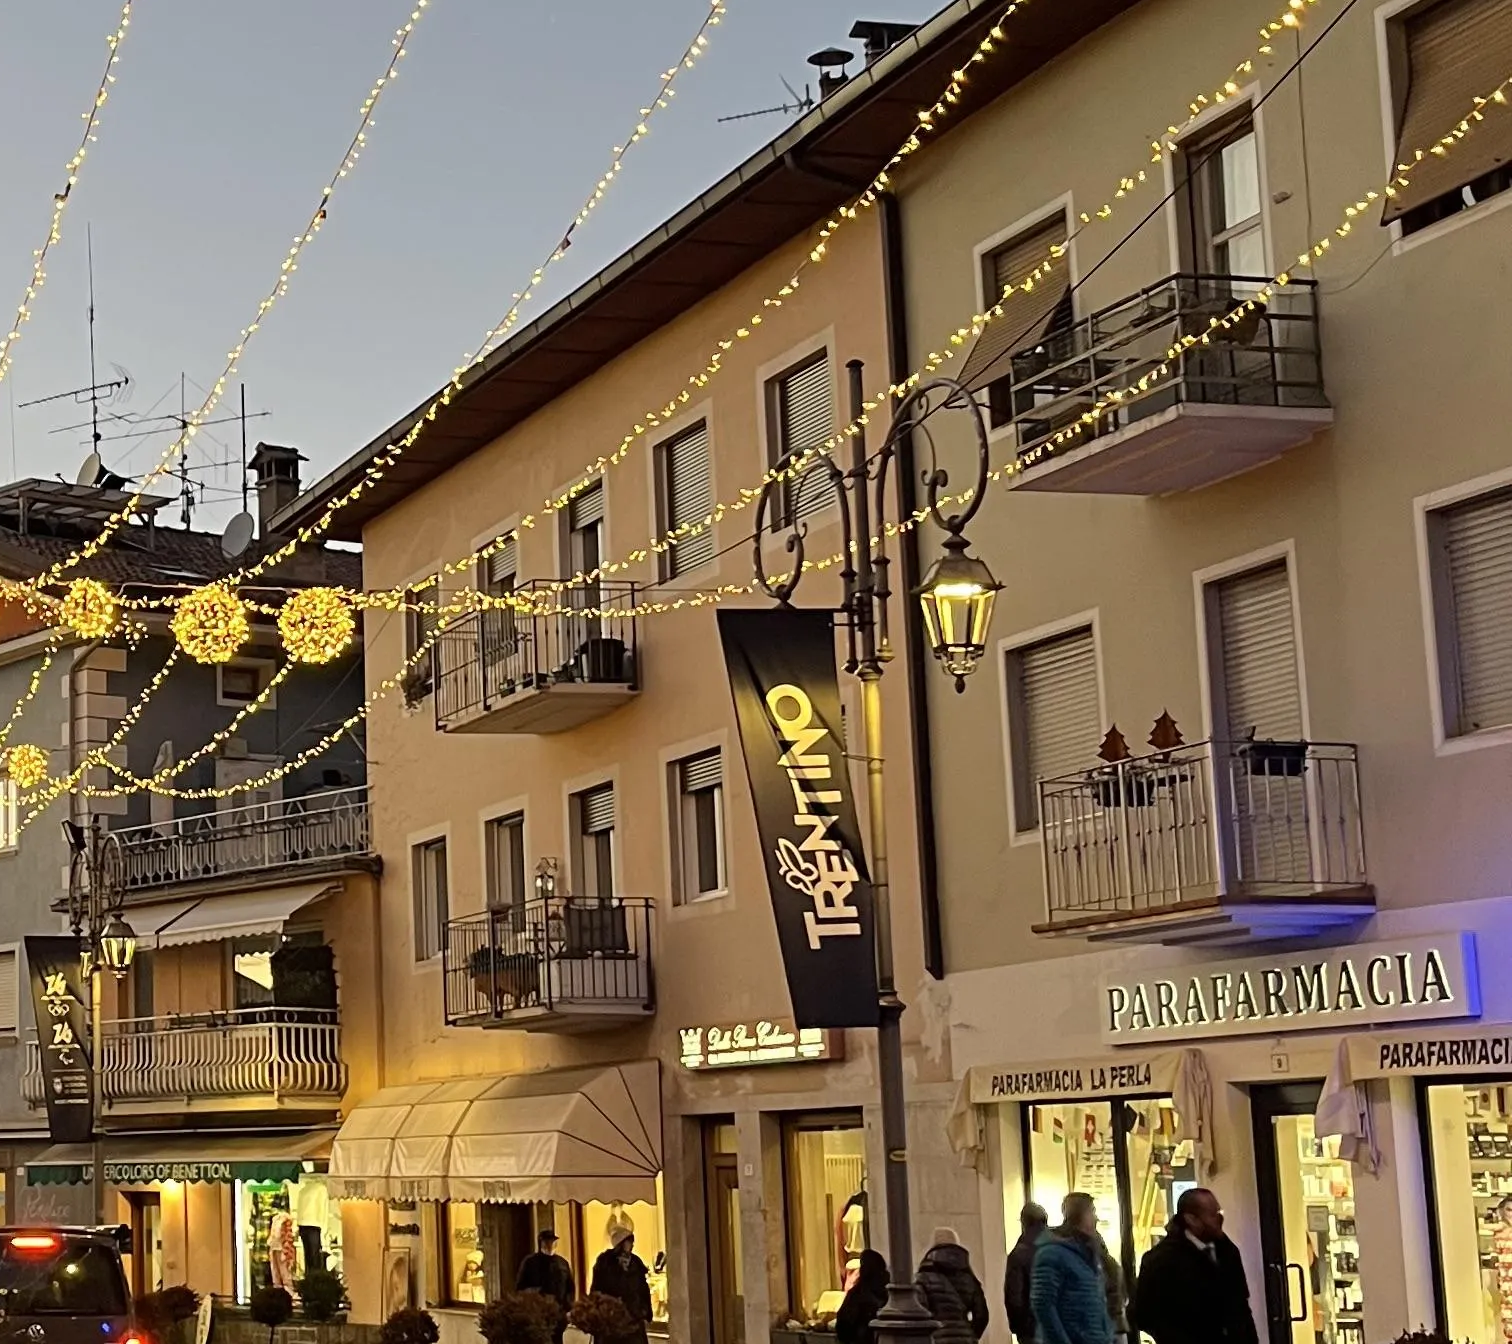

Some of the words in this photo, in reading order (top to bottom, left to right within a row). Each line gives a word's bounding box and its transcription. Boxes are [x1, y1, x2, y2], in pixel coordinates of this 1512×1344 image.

[765, 683, 862, 951] TRENTINO
[1108, 948, 1456, 1032] PARAFARMACIA
[1379, 1037, 1512, 1070] PARAFARMACI
[991, 1069, 1083, 1097] PARAFARMACIA
[1090, 1067, 1107, 1091] LA
[1110, 1063, 1152, 1089] PERLA
[82, 1163, 155, 1180] UNERCOLORS
[156, 1164, 172, 1179] OF
